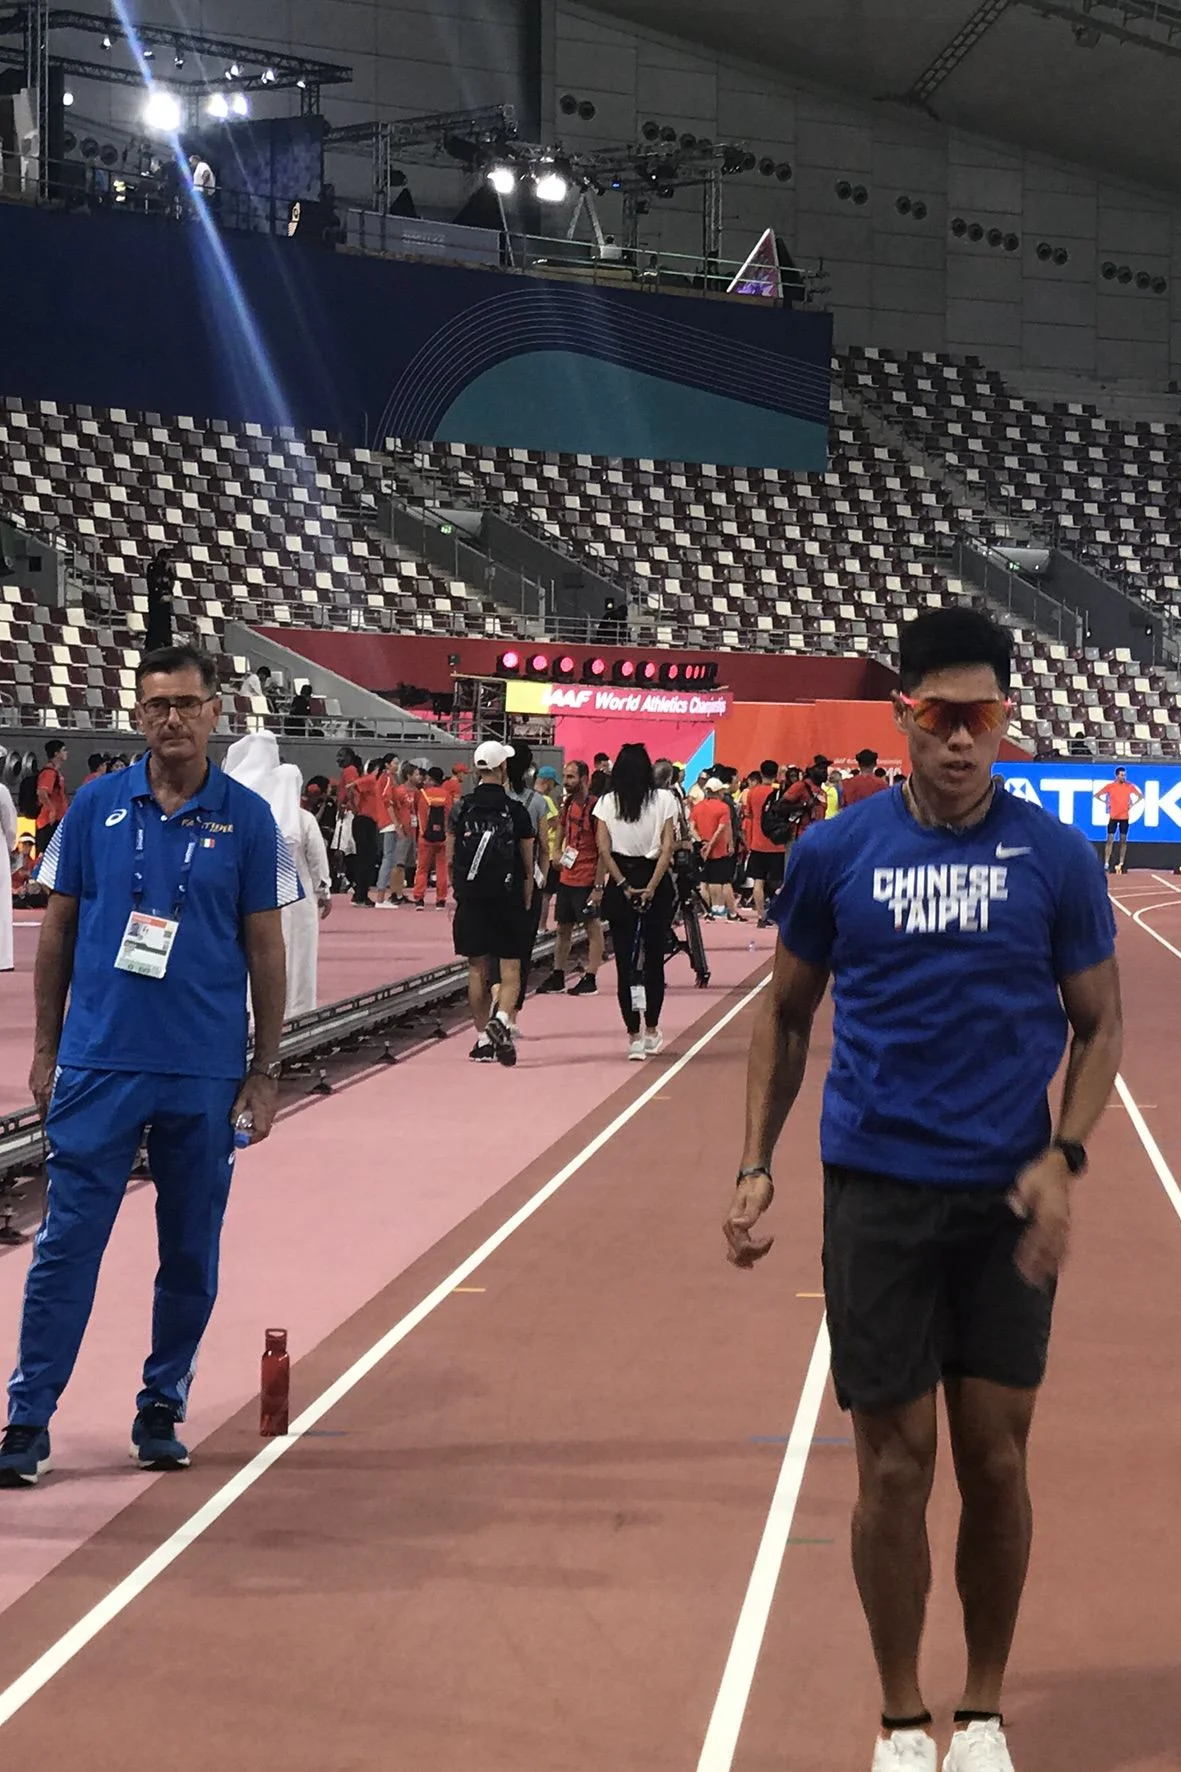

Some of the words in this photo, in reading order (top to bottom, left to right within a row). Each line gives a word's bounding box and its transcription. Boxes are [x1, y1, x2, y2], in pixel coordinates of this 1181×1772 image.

[542, 688, 593, 708] IAAF
[595, 691, 641, 712] World
[640, 694, 689, 713] Athletics
[873, 864, 1009, 902] CHINESE
[888, 897, 989, 934] TAIPEI
